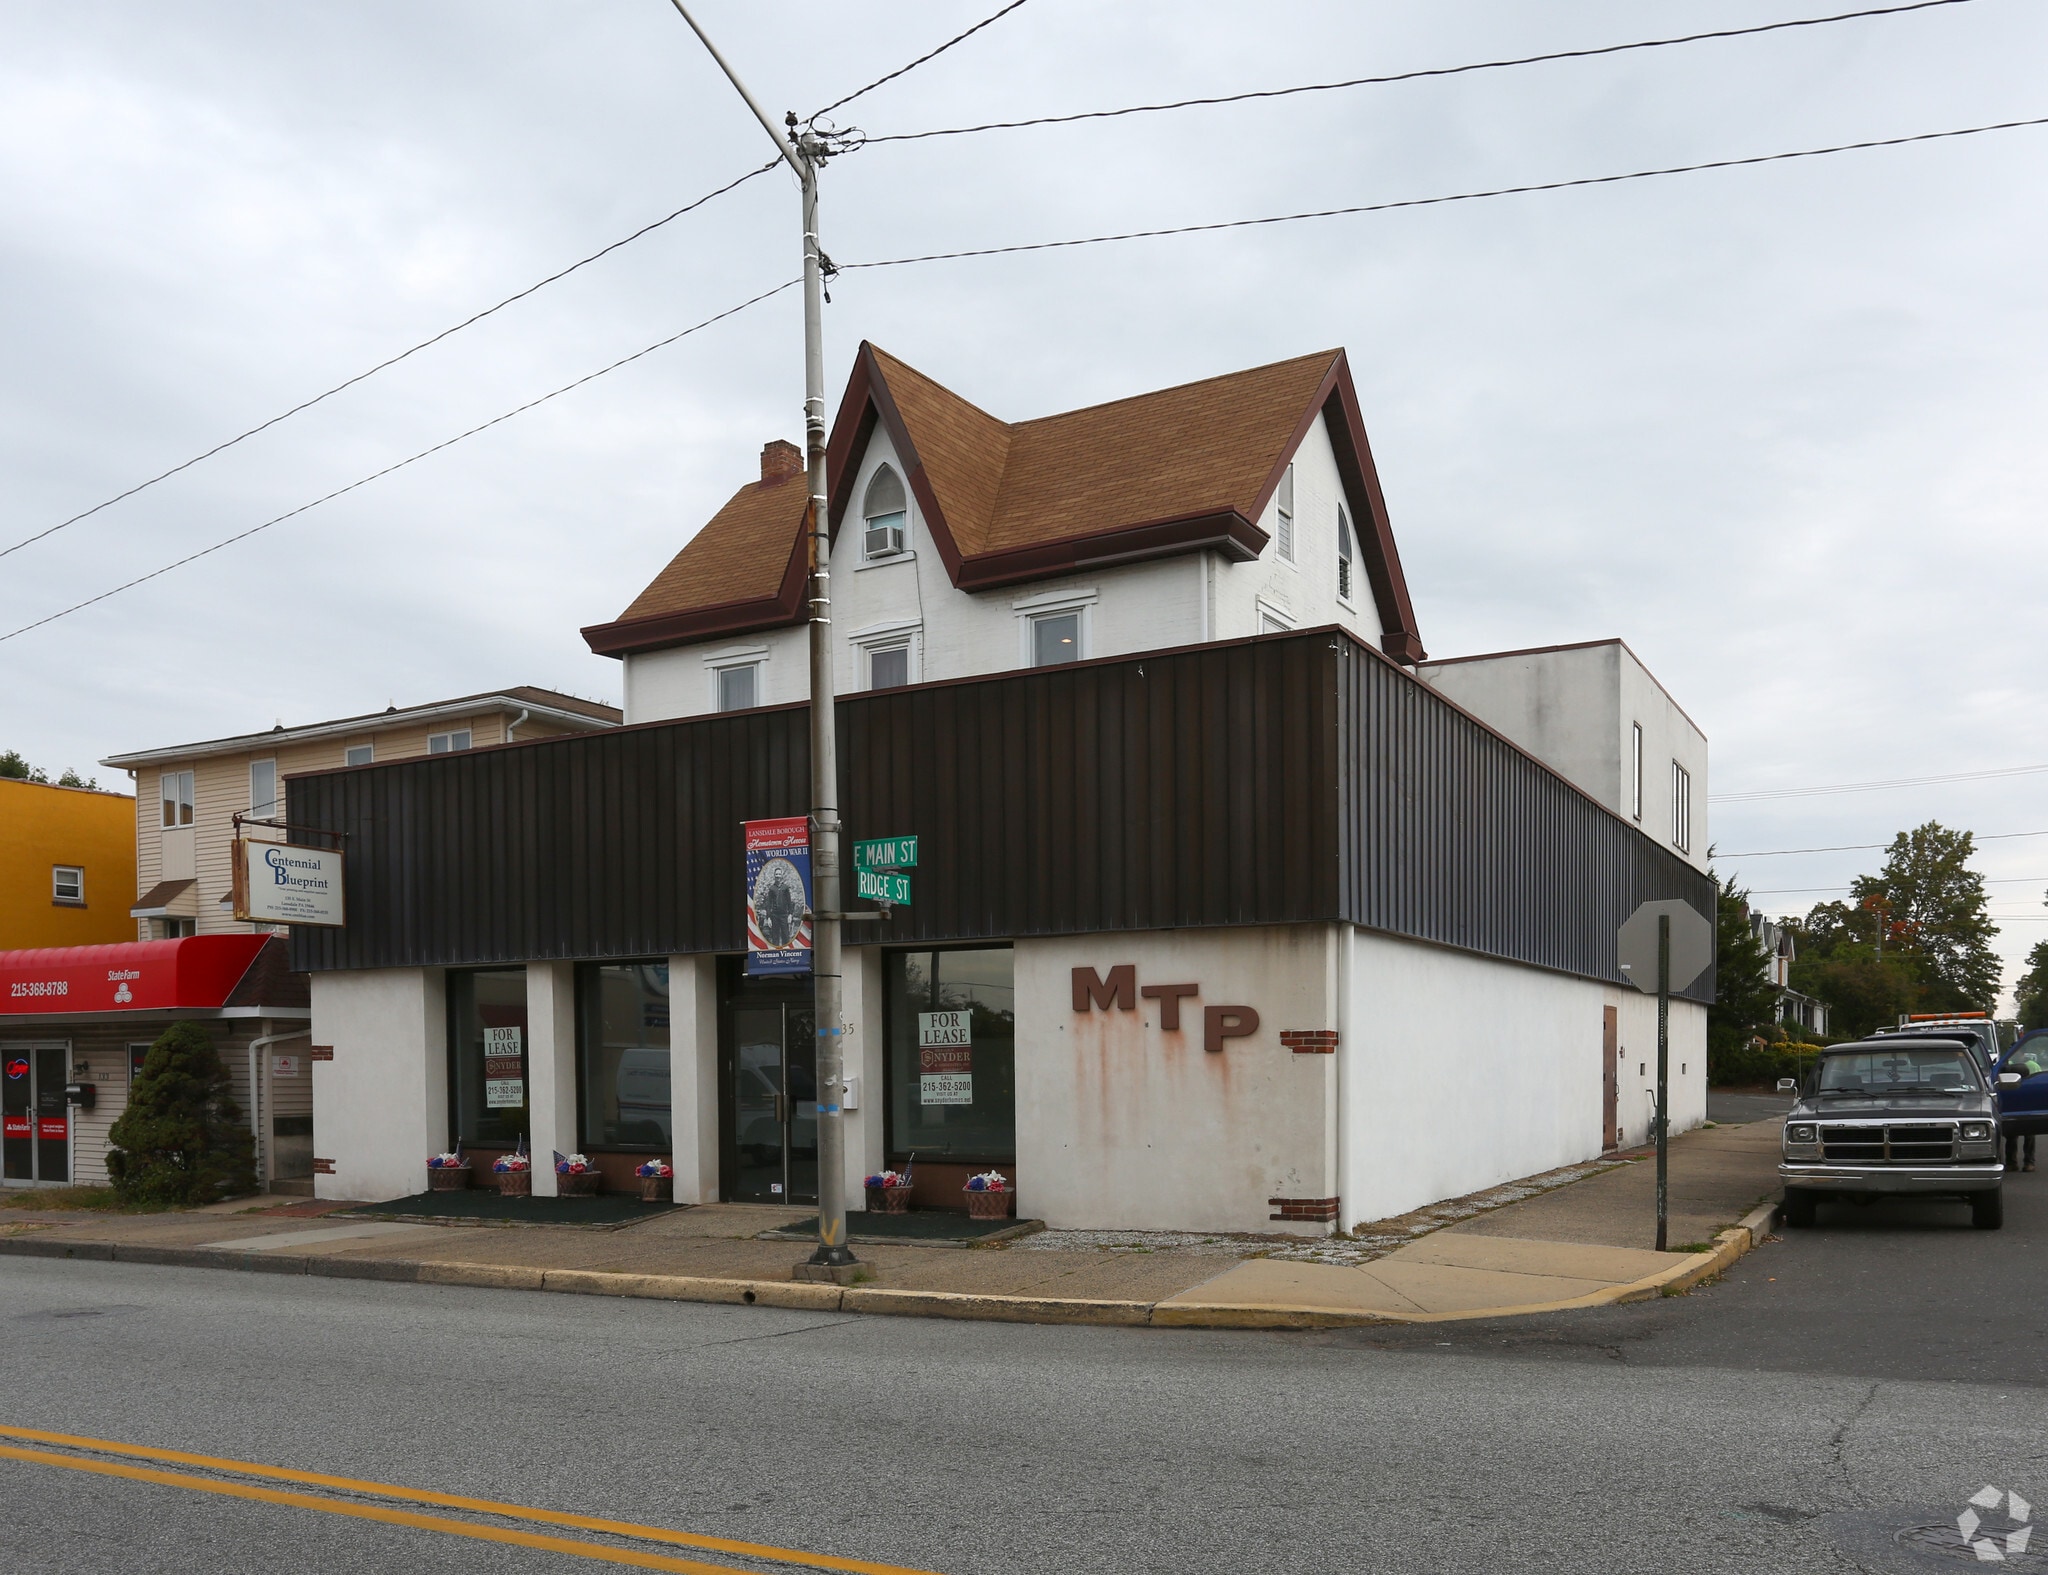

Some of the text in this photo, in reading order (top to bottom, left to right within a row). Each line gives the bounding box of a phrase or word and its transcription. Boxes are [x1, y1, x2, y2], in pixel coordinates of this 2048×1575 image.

[748, 826, 805, 837] LANSDALE BOROUGH
[747, 839, 782, 850] Hometown
[765, 847, 808, 857] WORLD WAR II
[265, 848, 321, 870] Centennial
[854, 840, 916, 867] E MAIN ST
[274, 866, 328, 889] Blueprint
[860, 871, 909, 901] RIDGE ST
[756, 950, 803, 959] Norman Vincent
[11, 981, 68, 997] 215-368-8788
[931, 1012, 960, 1028] FOR
[492, 1028, 514, 1041] FOR
[924, 1028, 967, 1044] LEASE
[488, 1041, 518, 1055] LEASE
[923, 1081, 970, 1091] 215-362-5200
